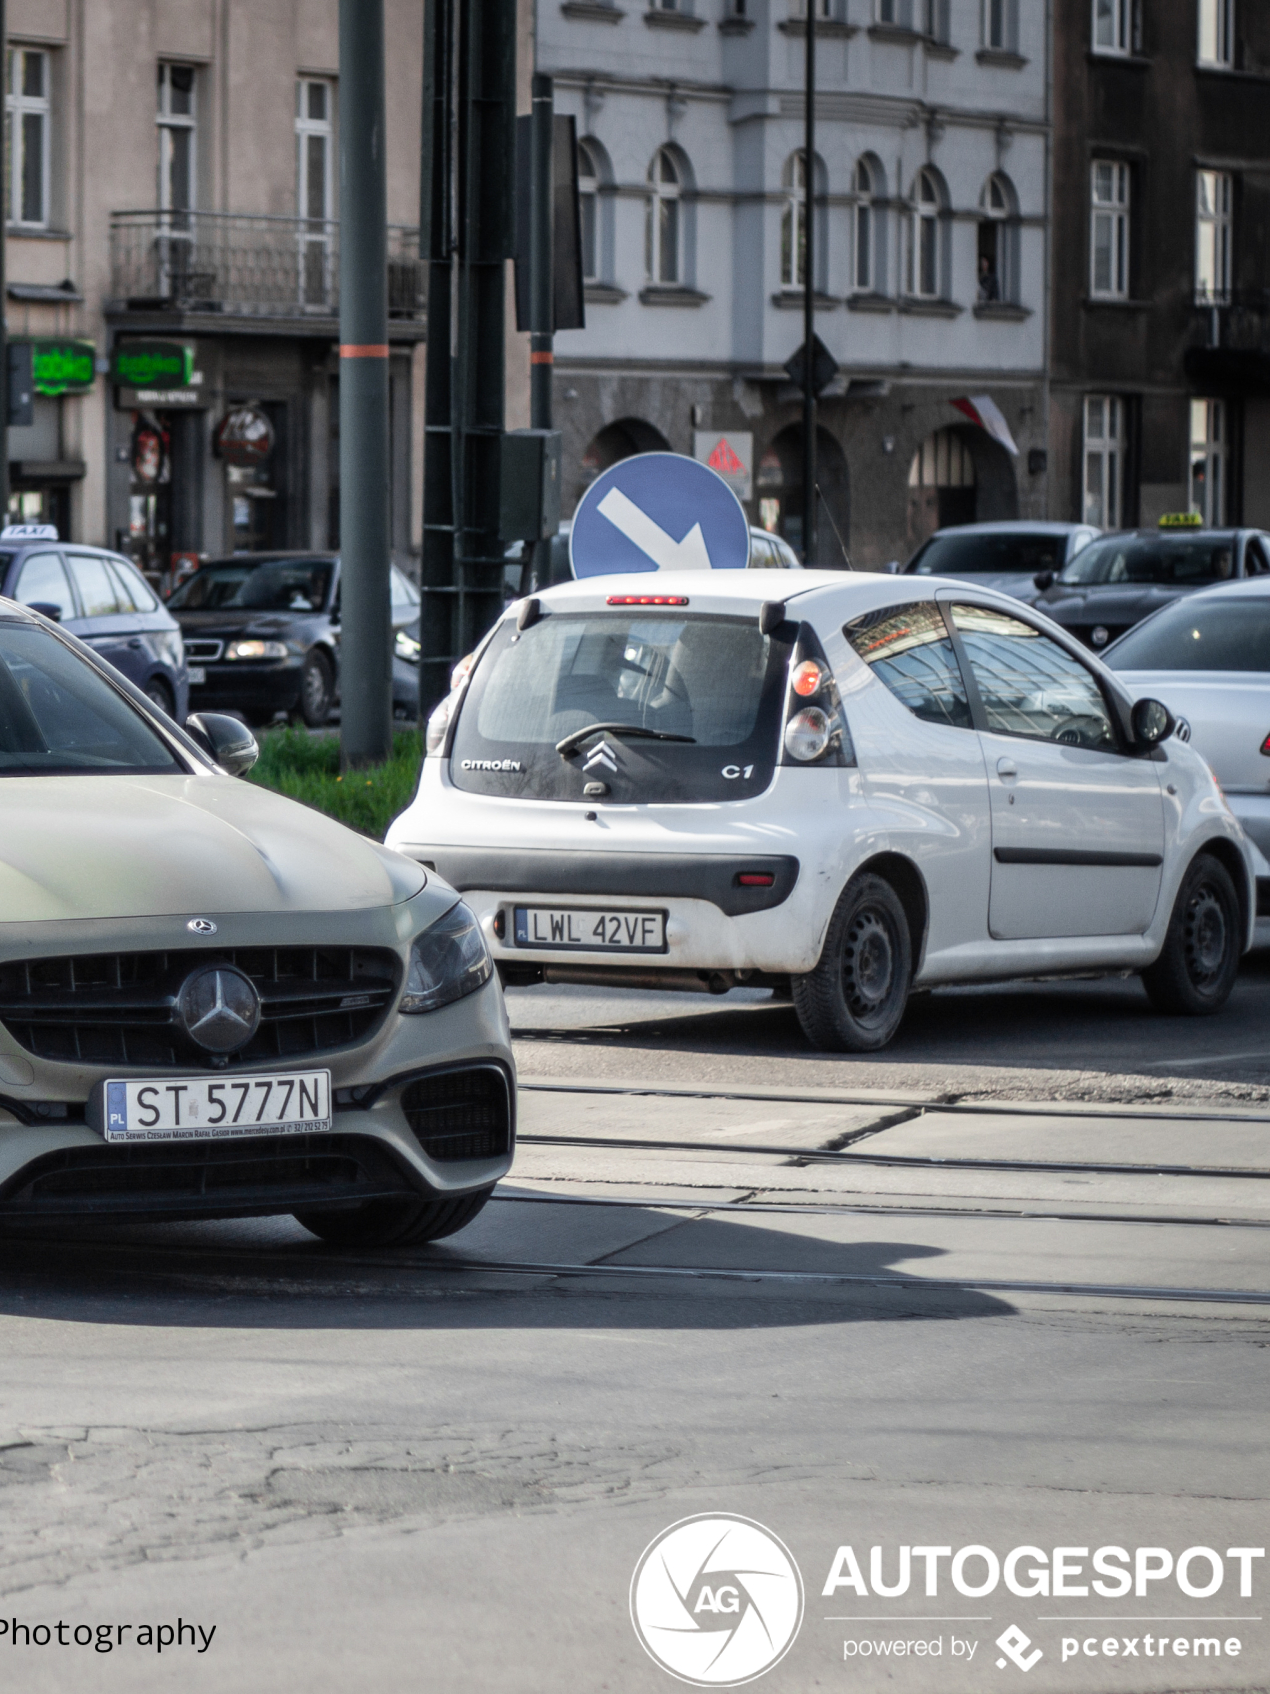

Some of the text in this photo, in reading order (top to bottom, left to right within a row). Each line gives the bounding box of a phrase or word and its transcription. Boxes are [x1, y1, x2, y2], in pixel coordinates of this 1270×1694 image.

[8, 526, 47, 537] TAXI
[461, 759, 521, 771] CITROËN
[721, 764, 754, 779] C1
[518, 930, 527, 938] PL
[534, 913, 656, 945] LWL 42VF
[137, 1078, 319, 1126] ST 5777N
[110, 1113, 125, 1125] PL
